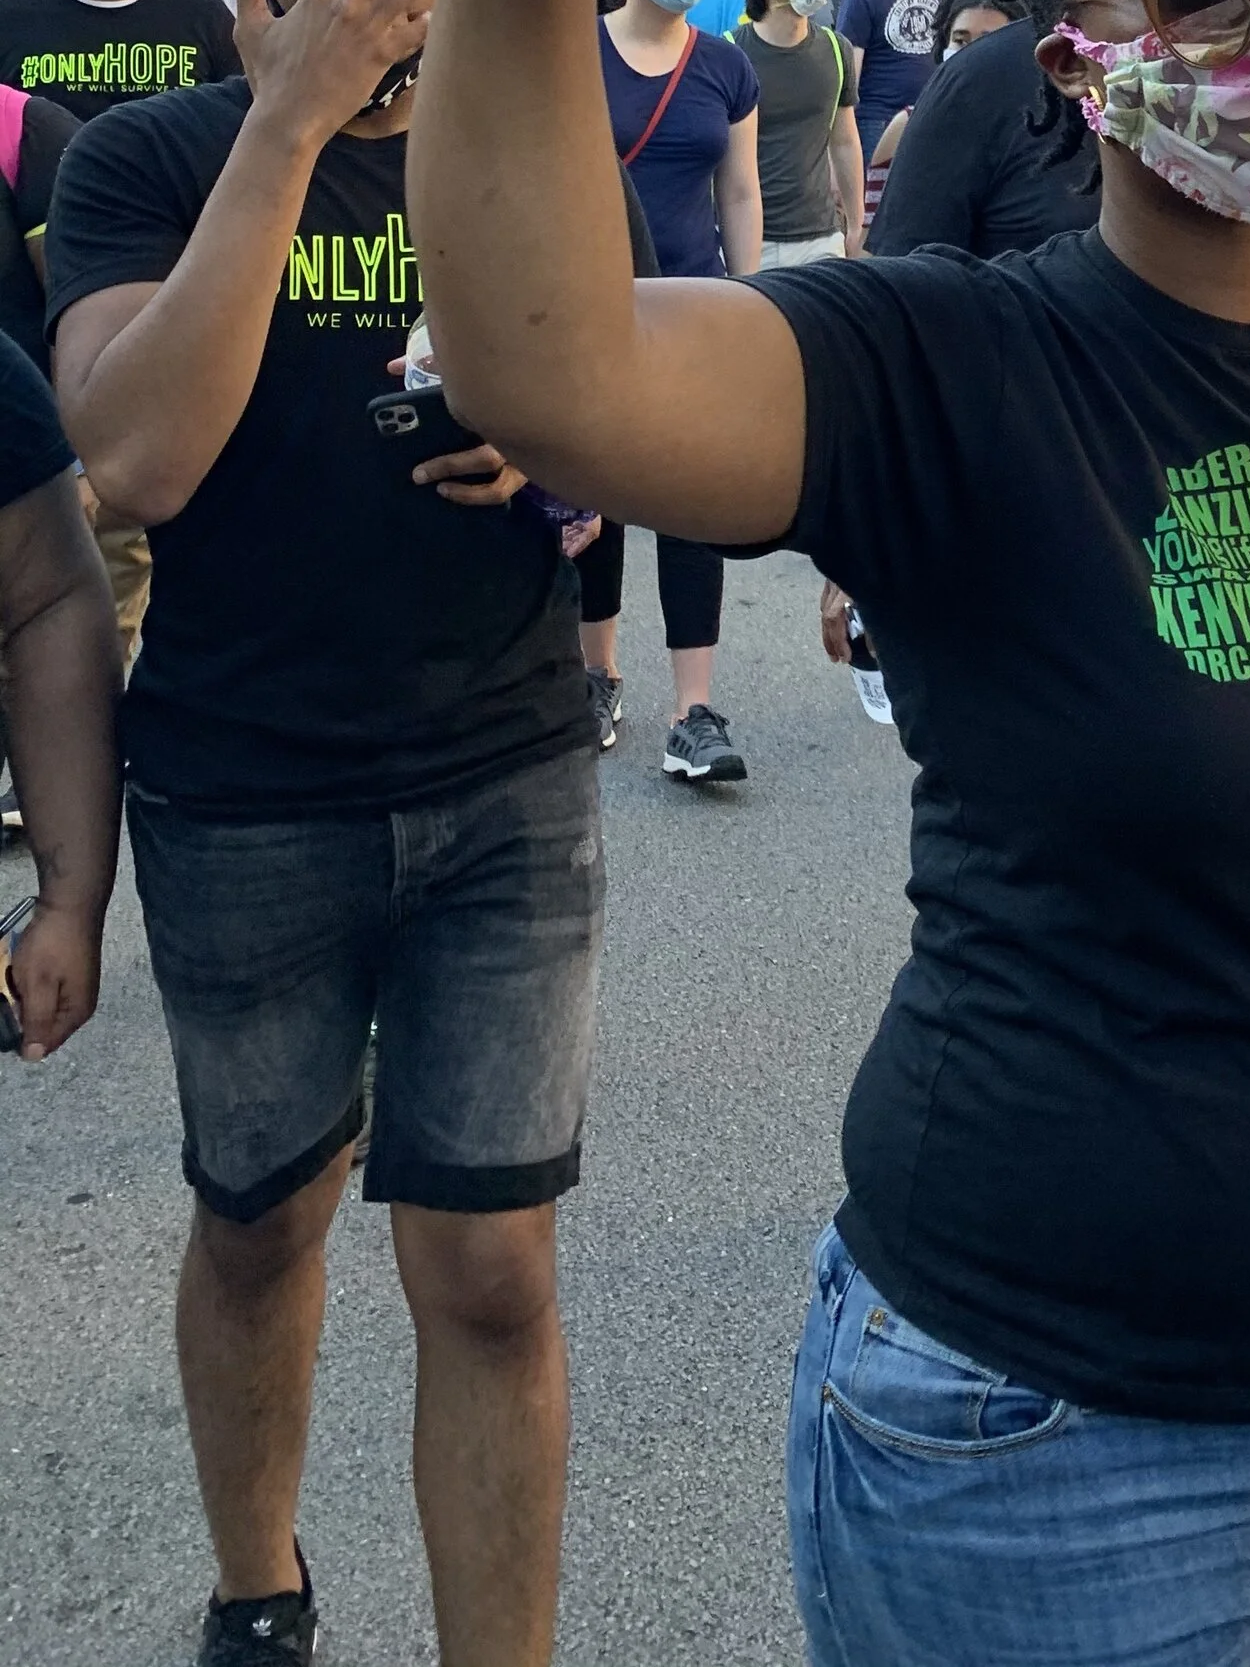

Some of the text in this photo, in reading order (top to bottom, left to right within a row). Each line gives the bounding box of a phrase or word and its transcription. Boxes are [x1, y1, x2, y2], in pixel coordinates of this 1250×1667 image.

[21, 43, 197, 88] #ONLYHOPE
[66, 84, 83, 92] WE
[88, 84, 115, 92] WILL
[307, 313, 411, 328] WE WILL
